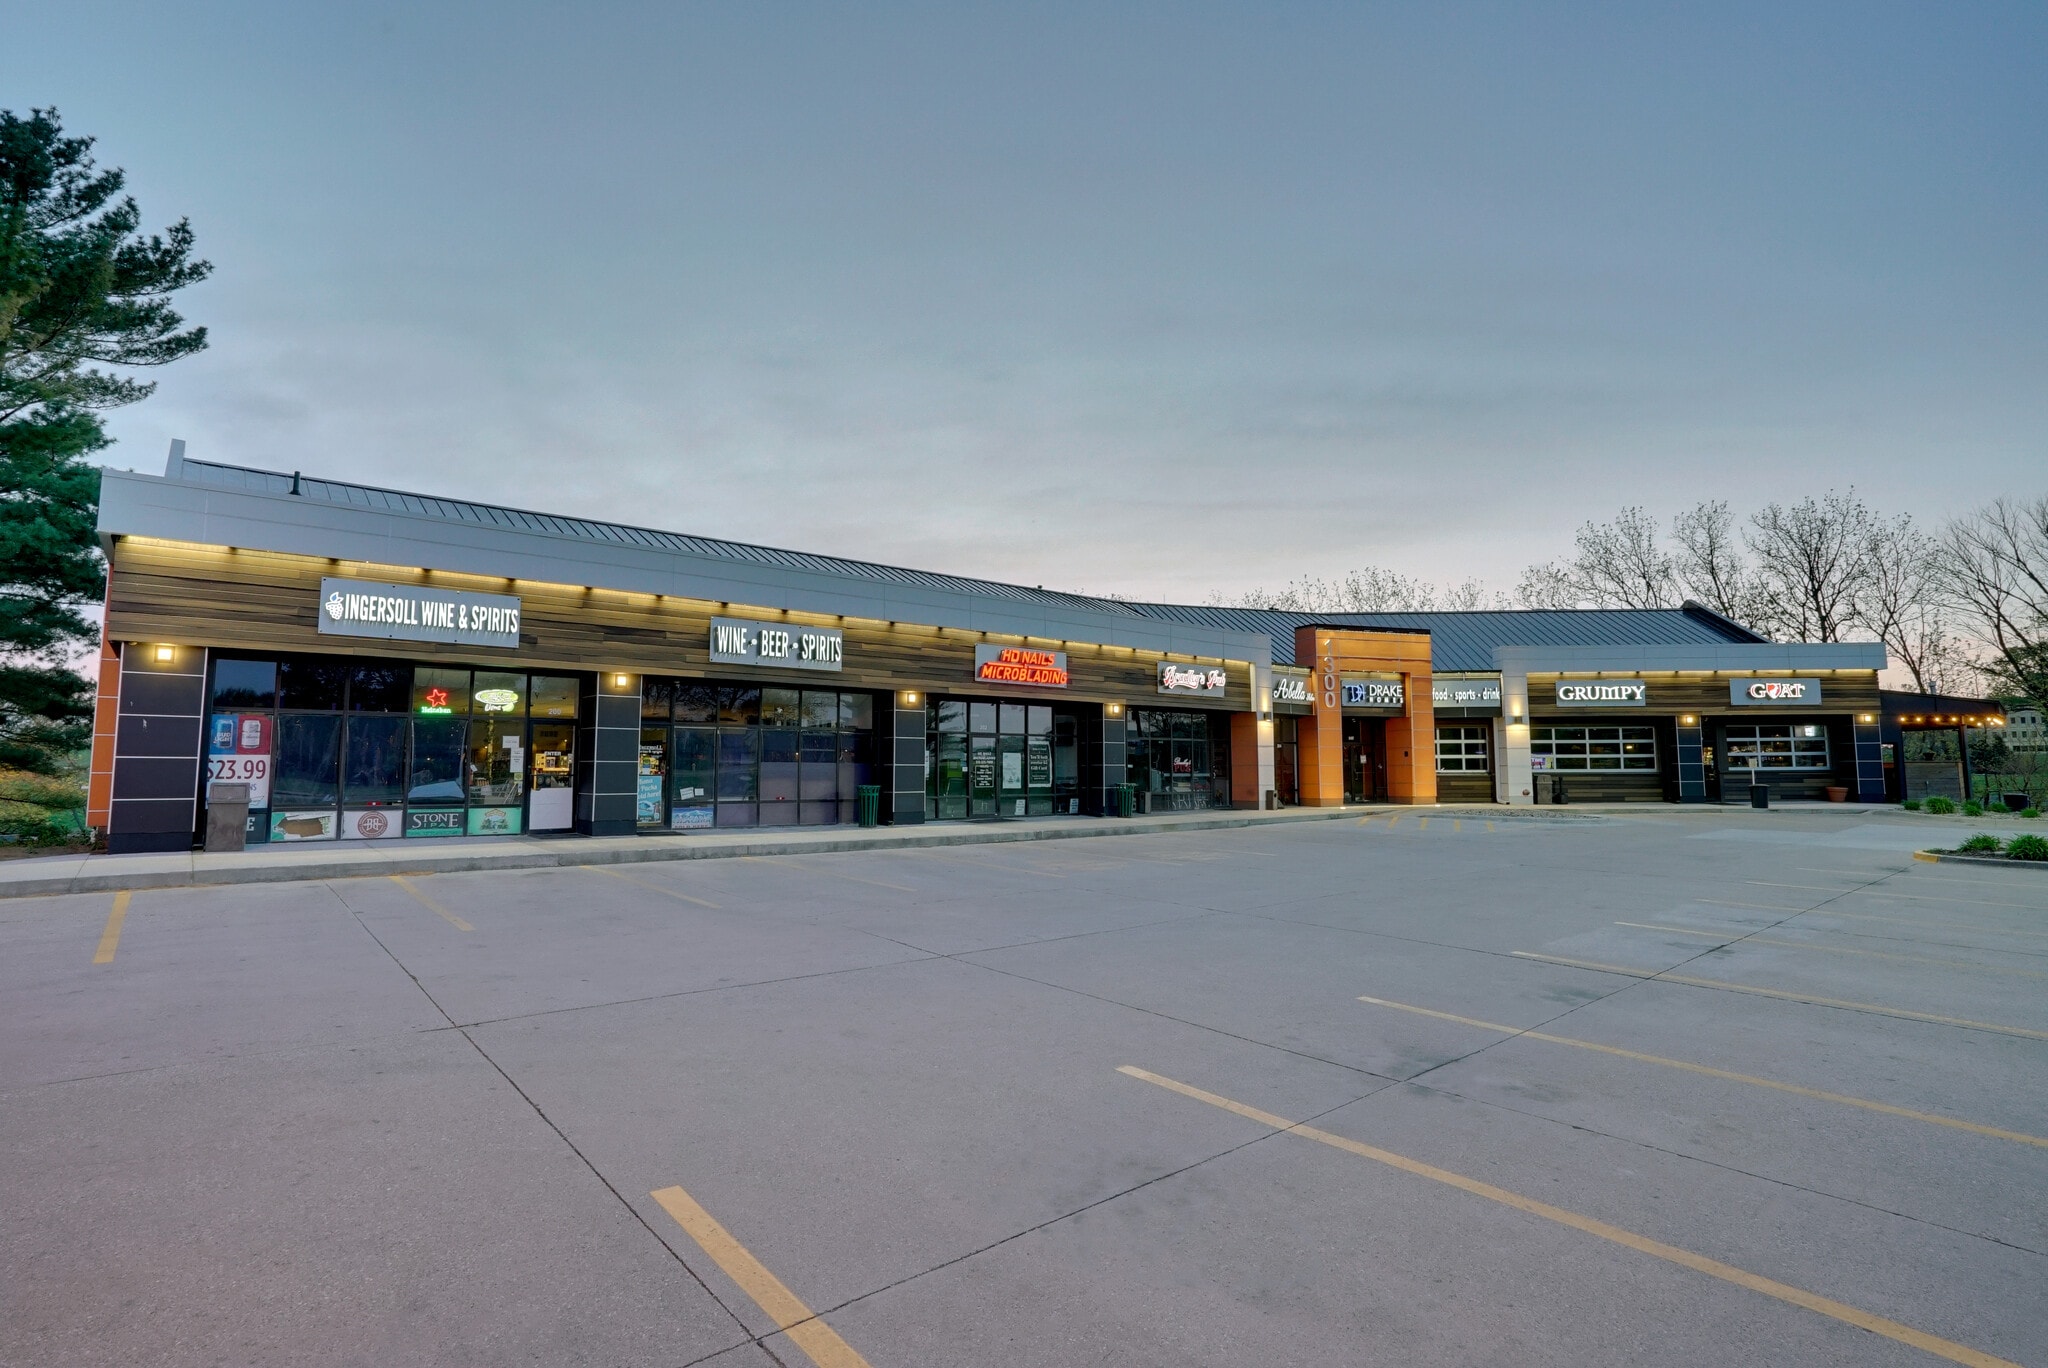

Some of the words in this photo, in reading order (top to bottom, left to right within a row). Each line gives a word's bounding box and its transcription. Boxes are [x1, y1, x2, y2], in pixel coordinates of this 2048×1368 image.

[344, 593, 418, 625] INGERSOLL
[421, 600, 455, 628] WINE
[458, 604, 468, 629] &
[470, 605, 519, 633] SPIRITS
[717, 625, 748, 654] WINE
[761, 629, 789, 658] BEER
[801, 633, 841, 662] SPIRITS
[1002, 649, 1020, 662] HD
[1021, 651, 1055, 666] NAILS
[981, 664, 1068, 685] MICROBLADING
[1323, 639, 1336, 708] 1300
[1273, 678, 1306, 700] Abella
[1369, 684, 1403, 697] DRAKE
[1432, 687, 1448, 701] food
[1455, 689, 1476, 703] sports
[1559, 685, 1645, 701] GRUMPY
[207, 757, 267, 781] $23.99
[412, 812, 459, 829] STONE
